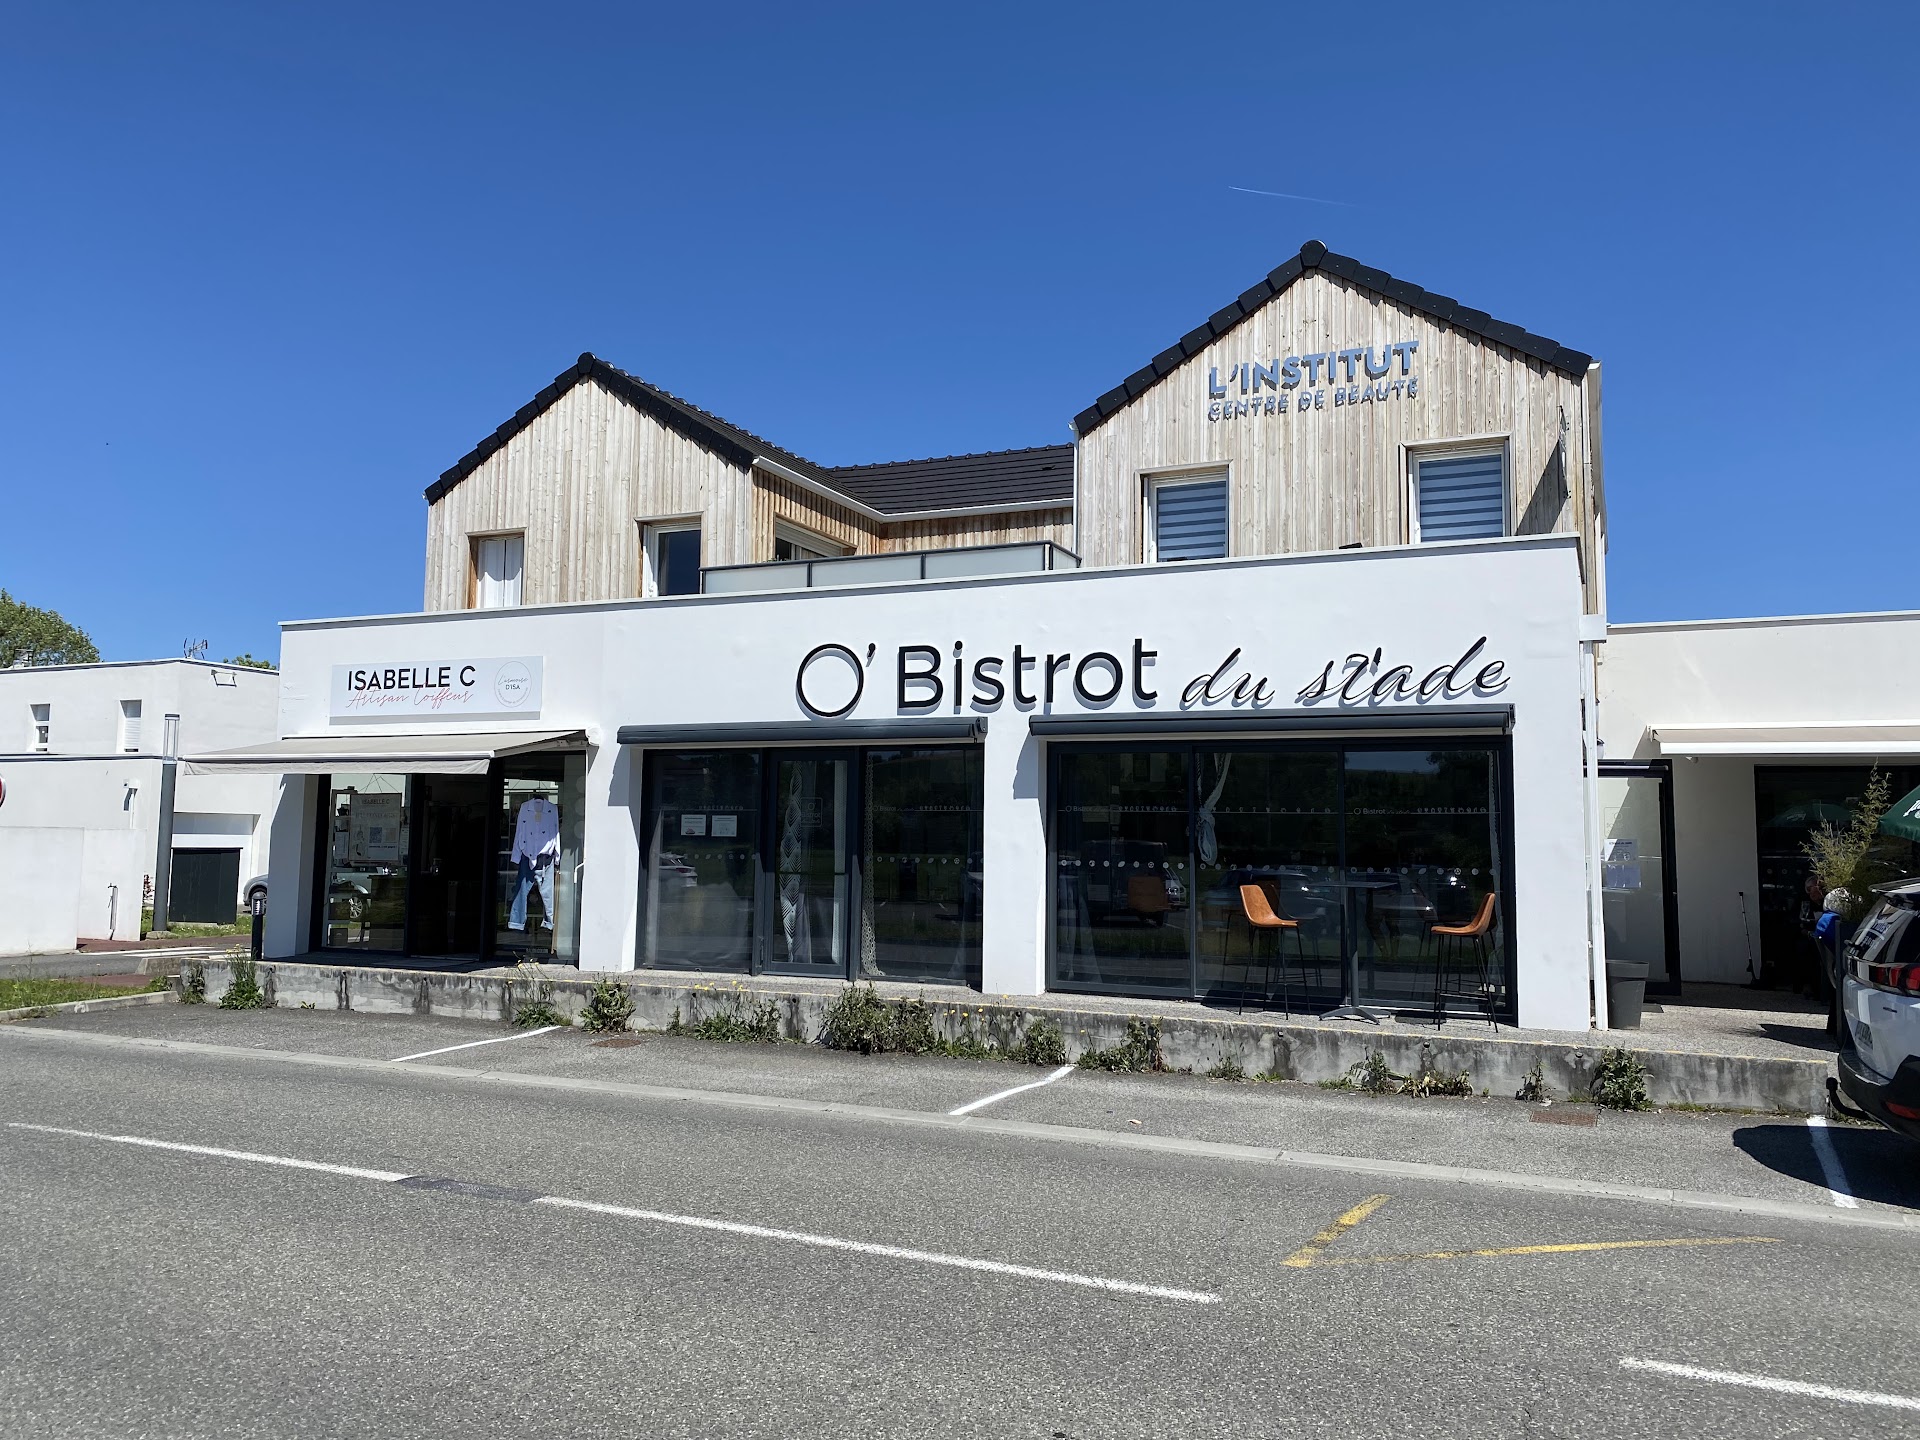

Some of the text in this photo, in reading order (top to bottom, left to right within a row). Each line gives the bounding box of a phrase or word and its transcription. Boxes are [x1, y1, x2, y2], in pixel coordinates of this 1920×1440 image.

[1210, 340, 1419, 394] L'INSTITUT
[1209, 393, 1289, 418] CENTRE
[1300, 389, 1325, 408] DE
[347, 665, 476, 691] ISABELLE C
[796, 636, 1511, 717] O' Bistrot du stade
[345, 685, 410, 709] Artisan
